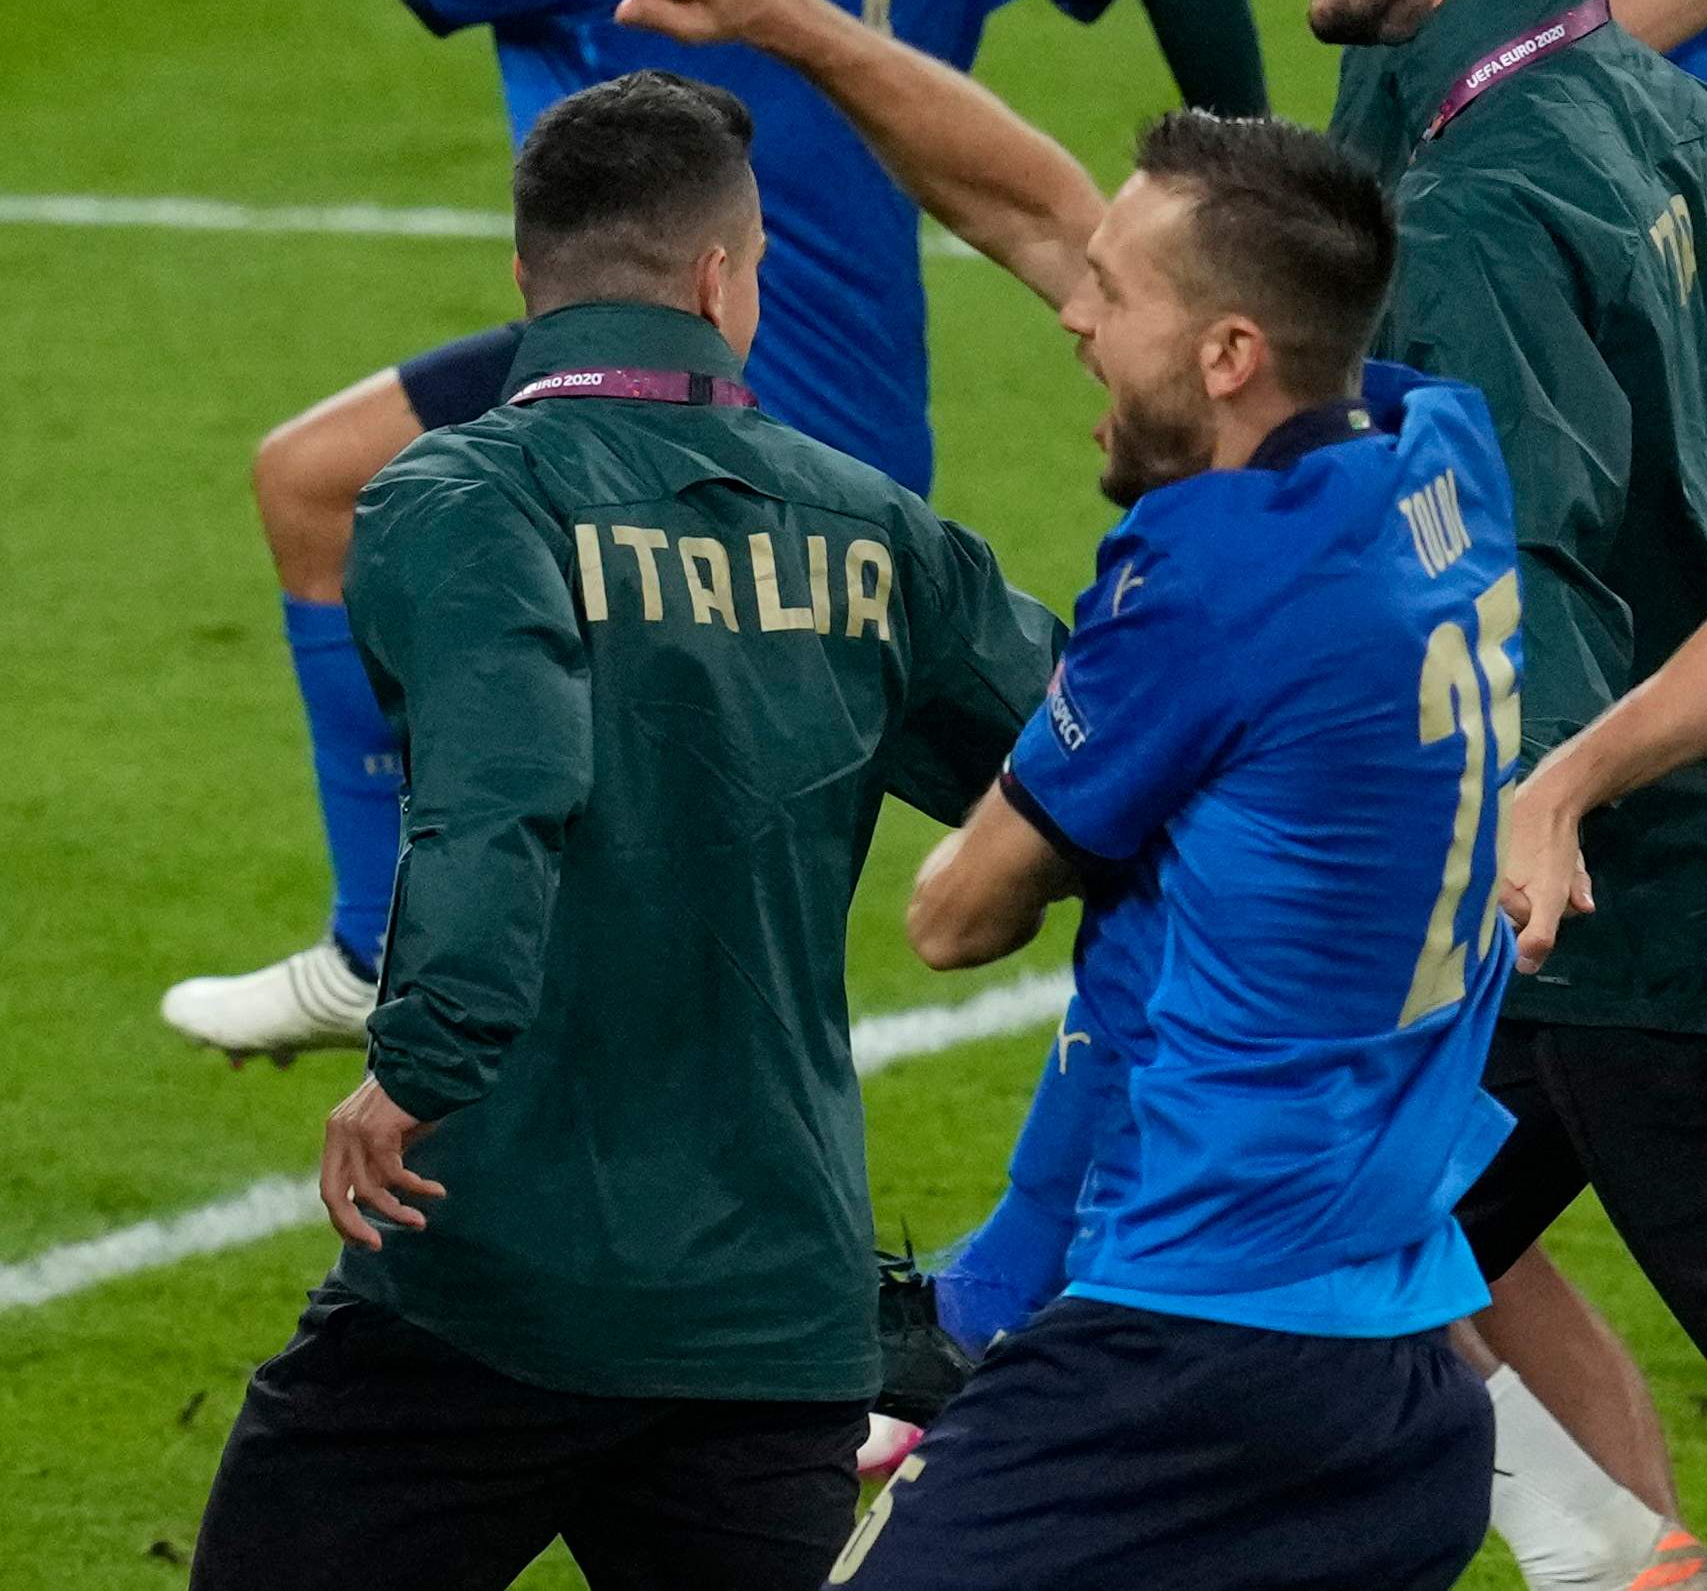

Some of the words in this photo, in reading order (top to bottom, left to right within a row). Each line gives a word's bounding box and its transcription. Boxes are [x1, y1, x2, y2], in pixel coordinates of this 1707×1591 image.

[1465, 60, 1504, 89] UEFA
[1499, 39, 1537, 67] EURO
[1535, 23, 1566, 48] 2020
[563, 373, 605, 387] 2020
[574, 523, 893, 642] ITALIA
[1398, 567, 1522, 1029] 25
